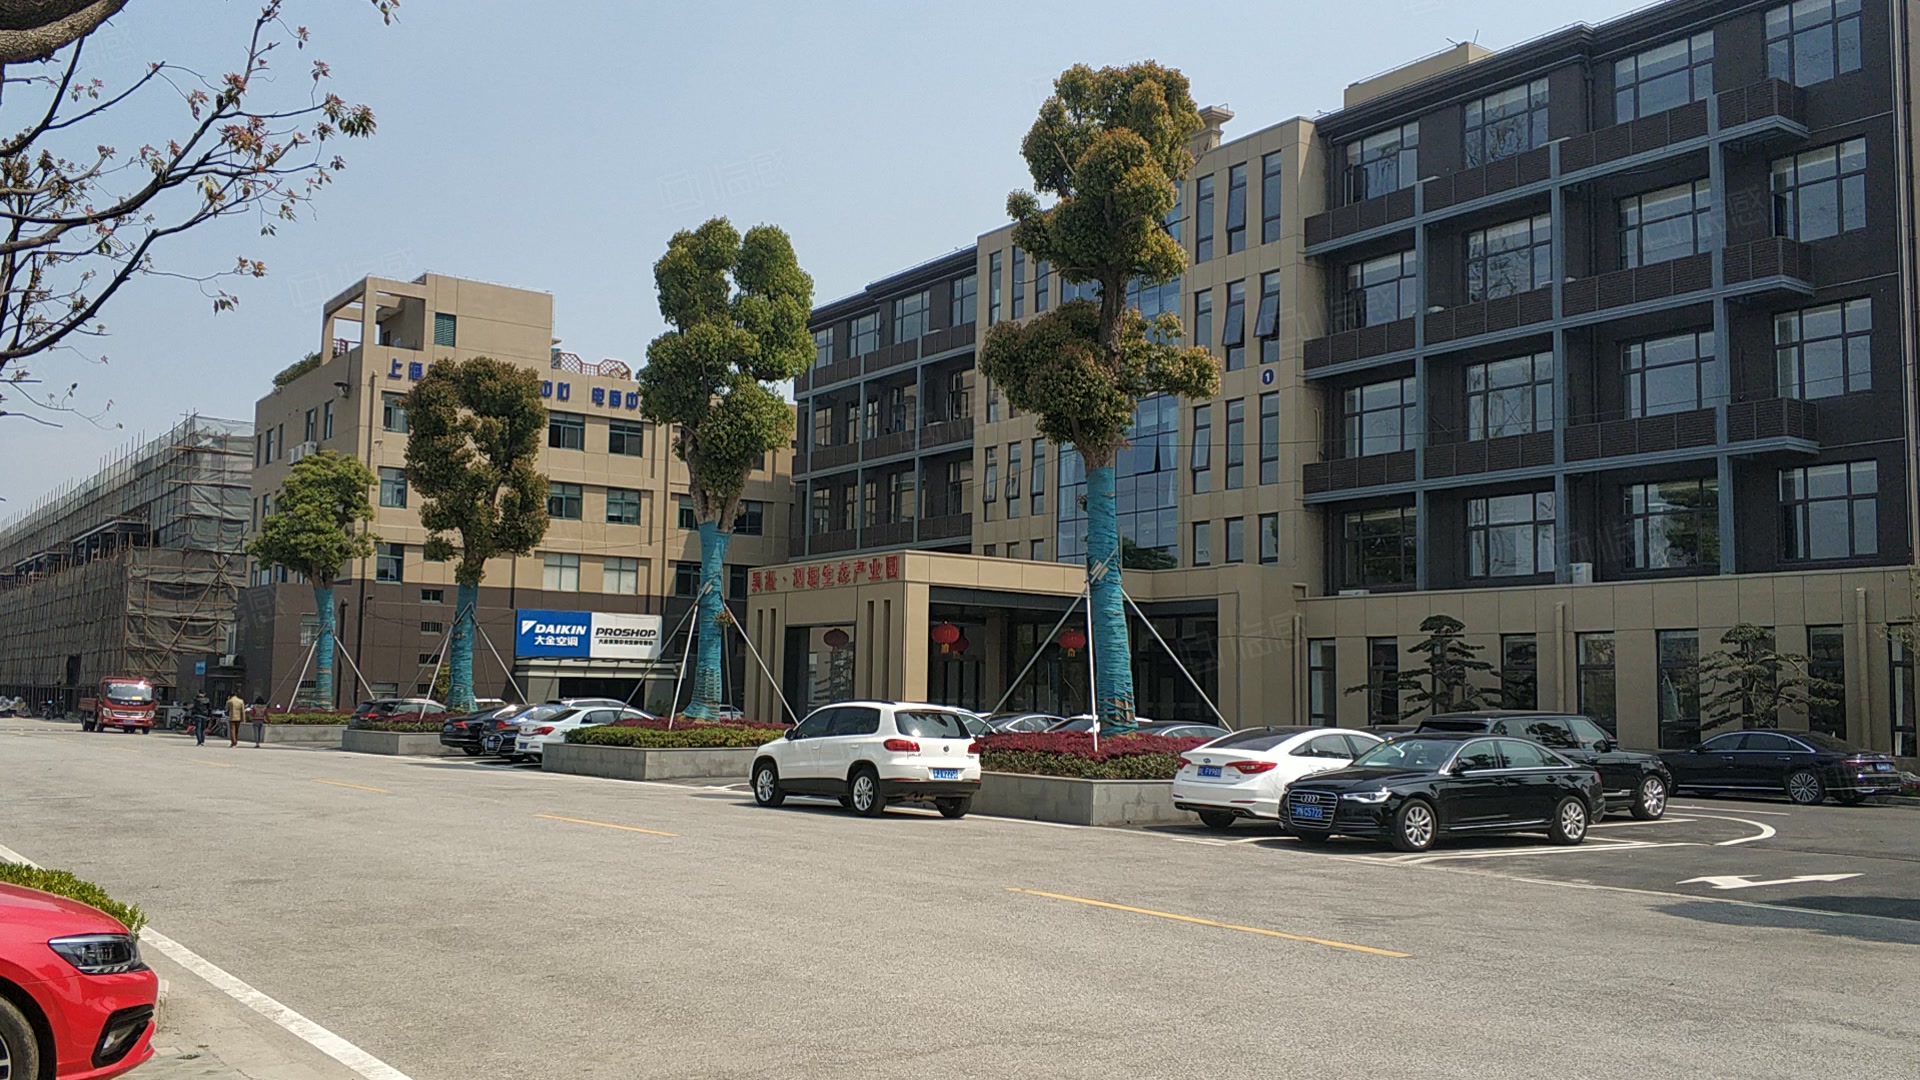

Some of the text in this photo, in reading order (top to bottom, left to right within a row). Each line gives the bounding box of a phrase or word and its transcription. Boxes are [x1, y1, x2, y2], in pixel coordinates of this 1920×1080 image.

[534, 624, 587, 635] DAIKIN
[595, 627, 656, 638] PROSHOP
[534, 636, 578, 647] 大金空调
